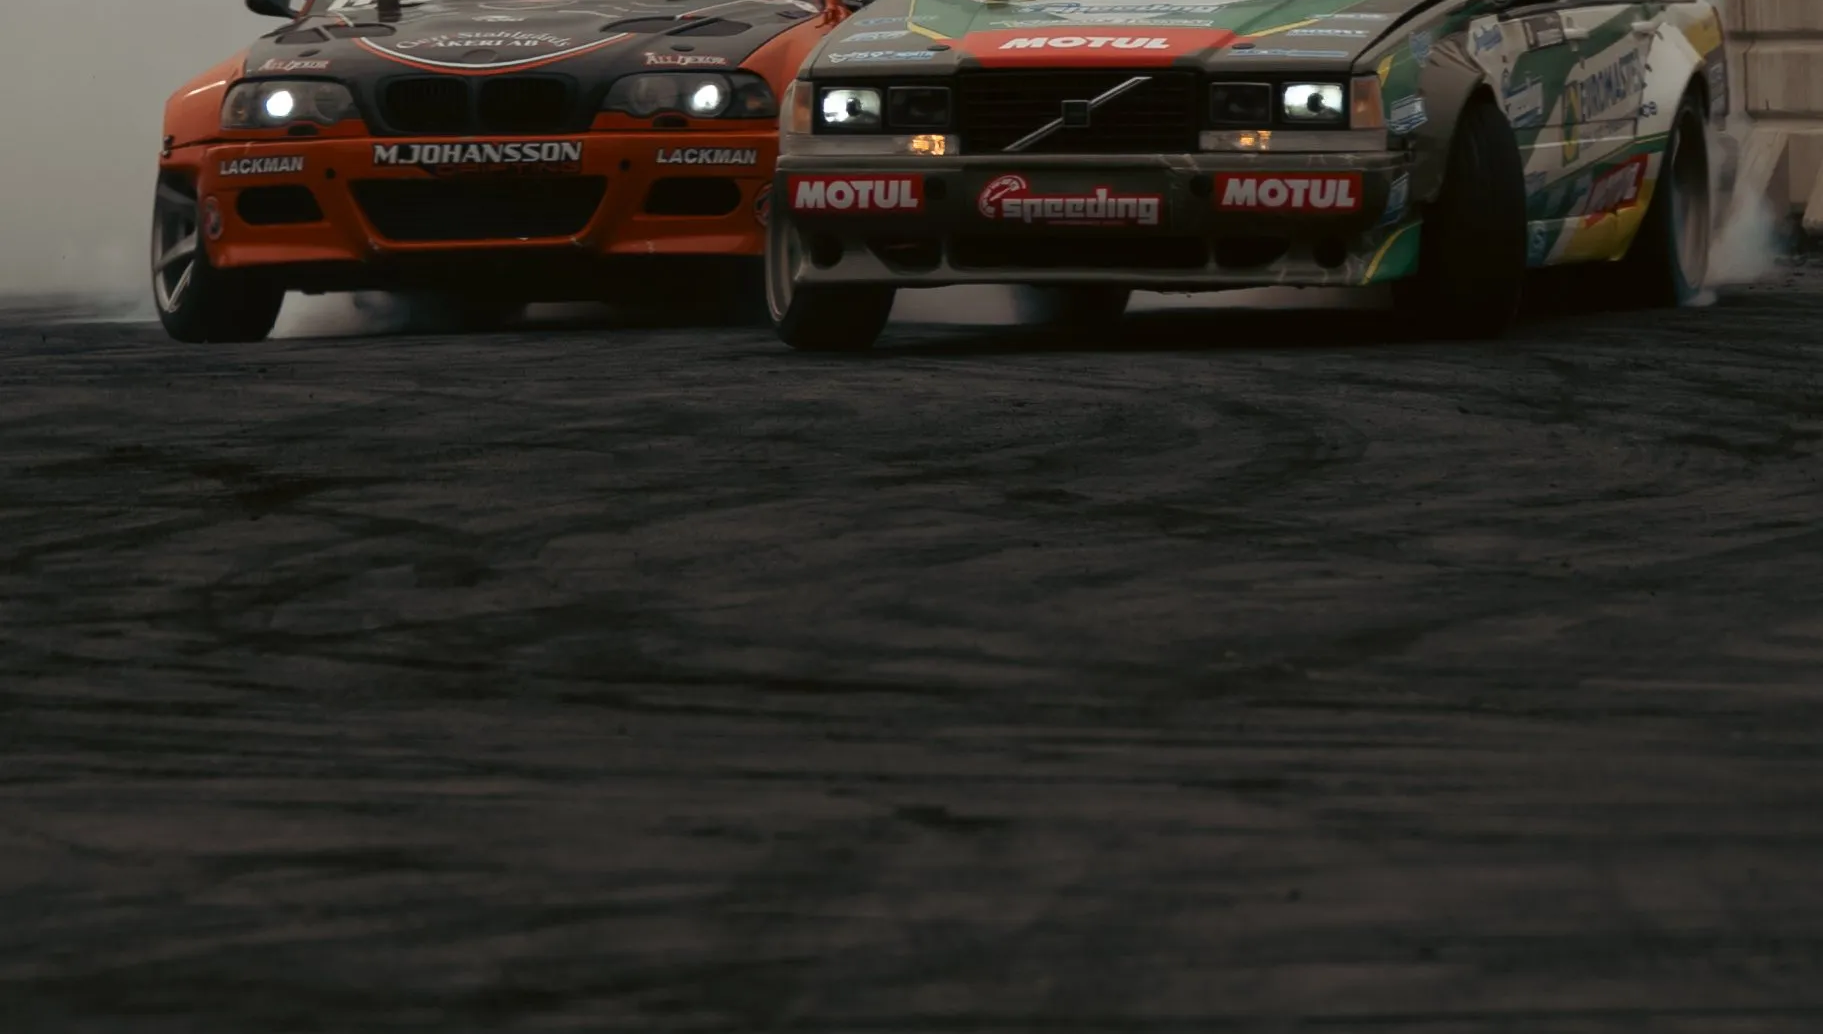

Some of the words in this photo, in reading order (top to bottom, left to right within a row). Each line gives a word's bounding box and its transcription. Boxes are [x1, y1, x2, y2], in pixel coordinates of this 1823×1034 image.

[998, 36, 1172, 50] MOTUL
[219, 156, 304, 176] LACKMAN
[656, 148, 757, 165] LACKMAN
[795, 180, 919, 209] MOTUL
[1221, 178, 1356, 208] MOTUL
